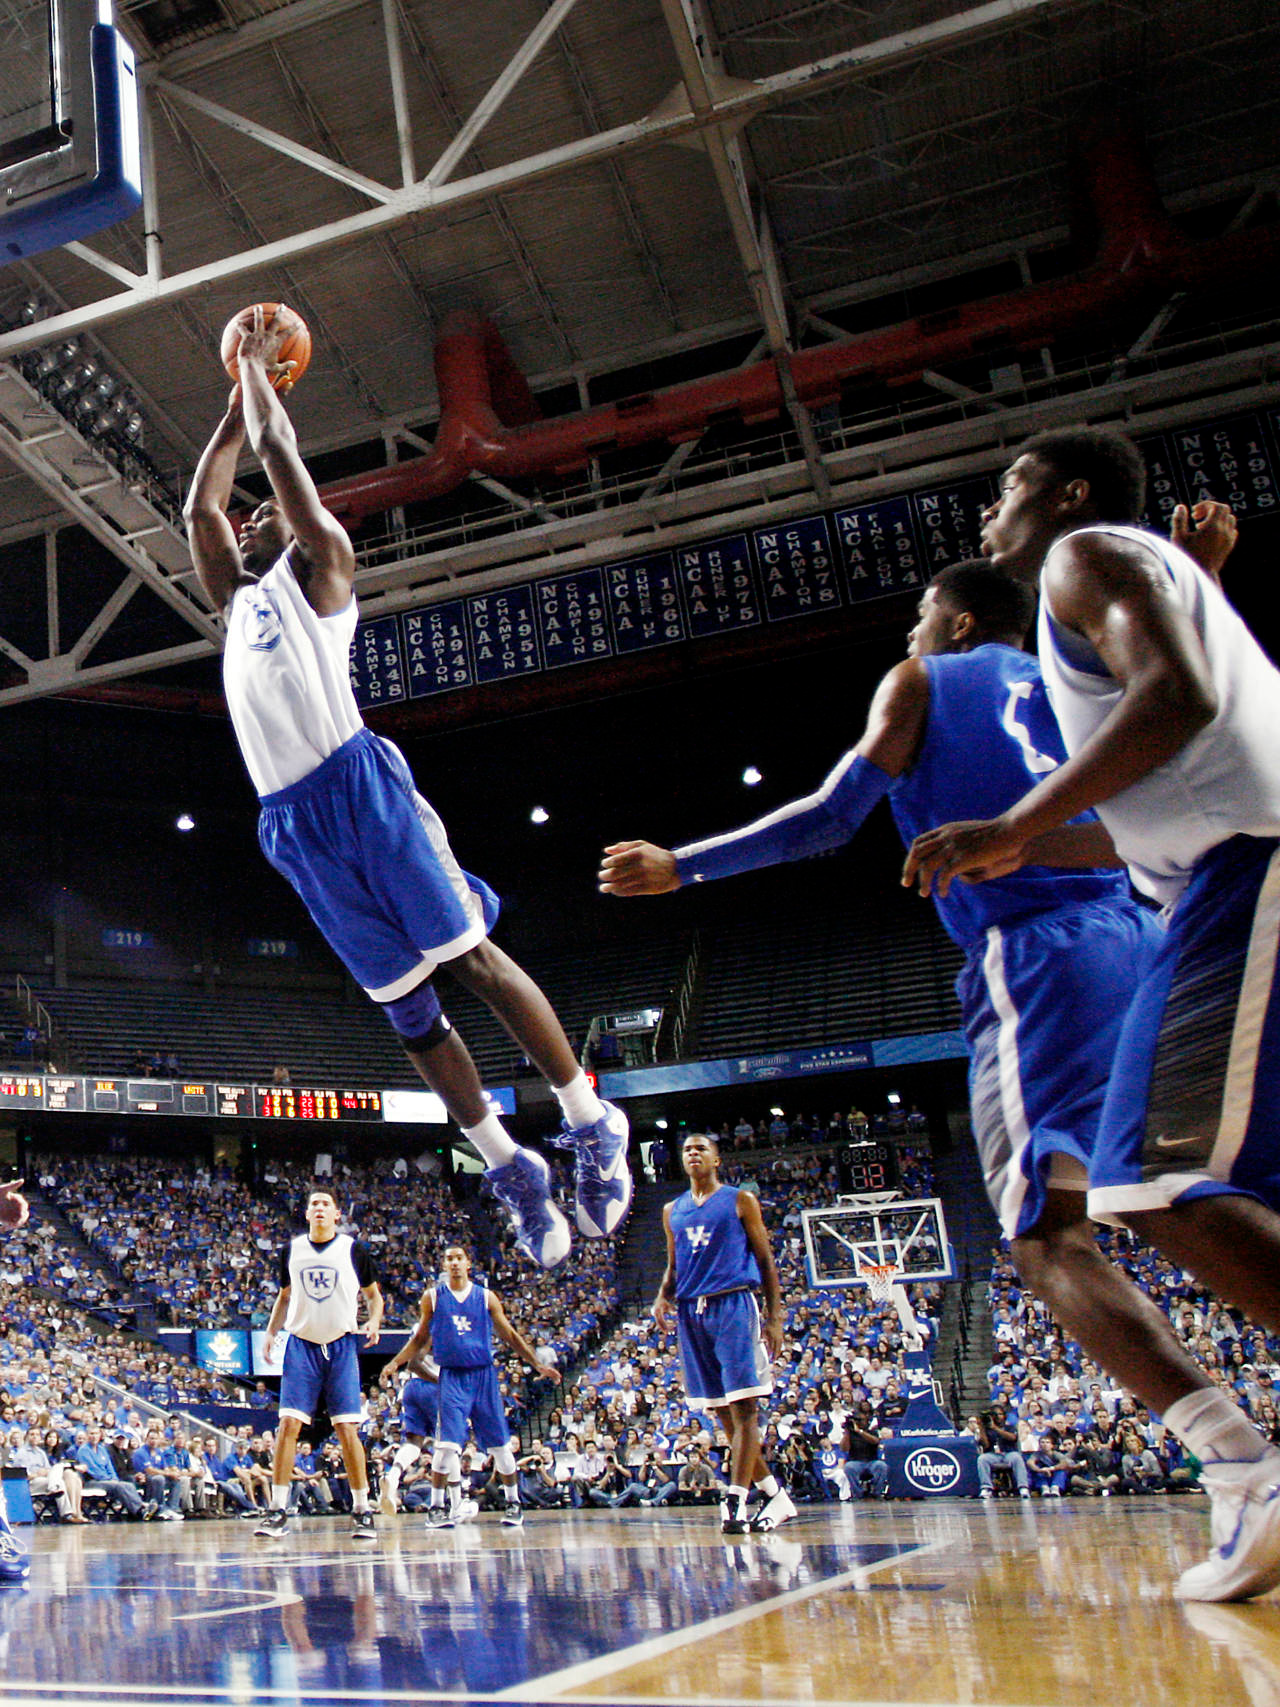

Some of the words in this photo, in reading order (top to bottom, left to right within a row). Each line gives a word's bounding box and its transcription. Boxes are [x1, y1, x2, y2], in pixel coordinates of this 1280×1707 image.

[1213, 431, 1247, 512] CHAMPION
[1246, 441, 1275, 508] 1998
[840, 514, 868, 580] NCAA
[867, 512, 885, 550] FINAL
[876, 556, 894, 587] FOUR
[893, 522, 919, 584] 1984
[921, 496, 950, 561] NCAA
[635, 568, 653, 616] RUNNER
[683, 552, 708, 615] NCAA
[708, 551, 727, 599] RUNNER
[731, 560, 754, 621] 1975
[759, 533, 787, 597] NCAA
[785, 531, 812, 606] CHAMPION
[811, 540, 835, 602] 1978
[472, 599, 493, 660] NCAA
[540, 584, 563, 647] NCAA
[565, 583, 585, 655] CHAMPION
[587, 592, 607, 653] 1958
[611, 568, 634, 631] NCAA
[642, 622, 656, 638] UP
[660, 577, 680, 638] 1966
[717, 605, 730, 622] UP
[364, 629, 382, 699] CHAMPION
[407, 616, 427, 677] NCAA
[430, 613, 448, 684] CHAMPION
[449, 625, 467, 683] 1949
[496, 598, 515, 669] CHAMPION
[517, 609, 535, 668] 1951
[349, 642, 361, 688] CAA
[384, 639, 402, 697] 1948
[117, 932, 142, 945] 219
[261, 941, 286, 954] 219
[96, 1081, 115, 1091] BLUE
[183, 1085, 205, 1095] WHITE
[301, 1097, 313, 1107] 22
[344, 1100, 356, 1108] 44
[302, 1107, 314, 1118] 25
[685, 1225, 712, 1247] UK
[308, 1271, 330, 1288] UK
[452, 1315, 472, 1331] UK
[902, 1368, 932, 1386] UK
[912, 1454, 955, 1485] Kroger
